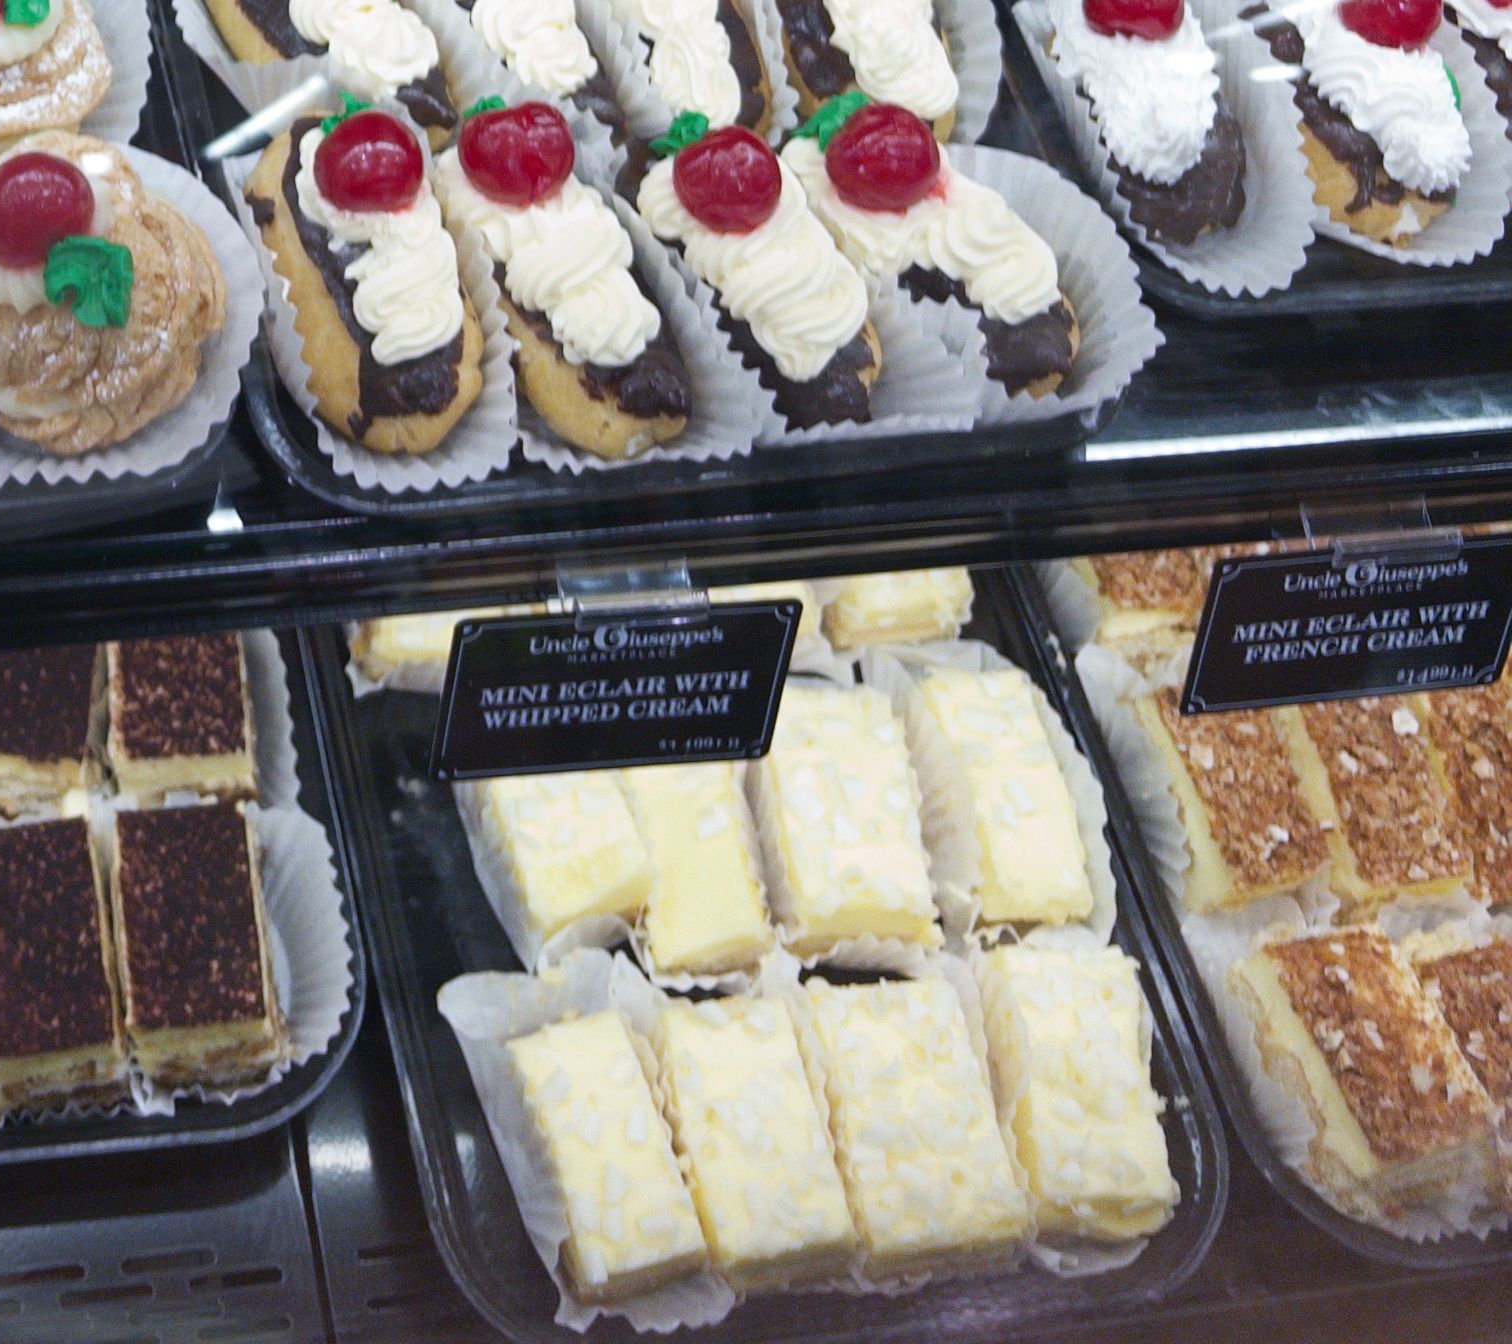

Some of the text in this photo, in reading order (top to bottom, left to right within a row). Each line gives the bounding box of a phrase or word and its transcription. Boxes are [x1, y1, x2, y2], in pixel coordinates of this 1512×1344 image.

[1283, 558, 1468, 593] Uncle Giuseppe's
[529, 623, 723, 656] Uncle Giuseppe's
[1233, 599, 1490, 644] MINI ECLAIR WITH
[1244, 624, 1467, 665] FRENCH CREAM
[480, 670, 750, 707] MINI ECLAIR WITH
[483, 695, 731, 730] WHIPPED CREAM
